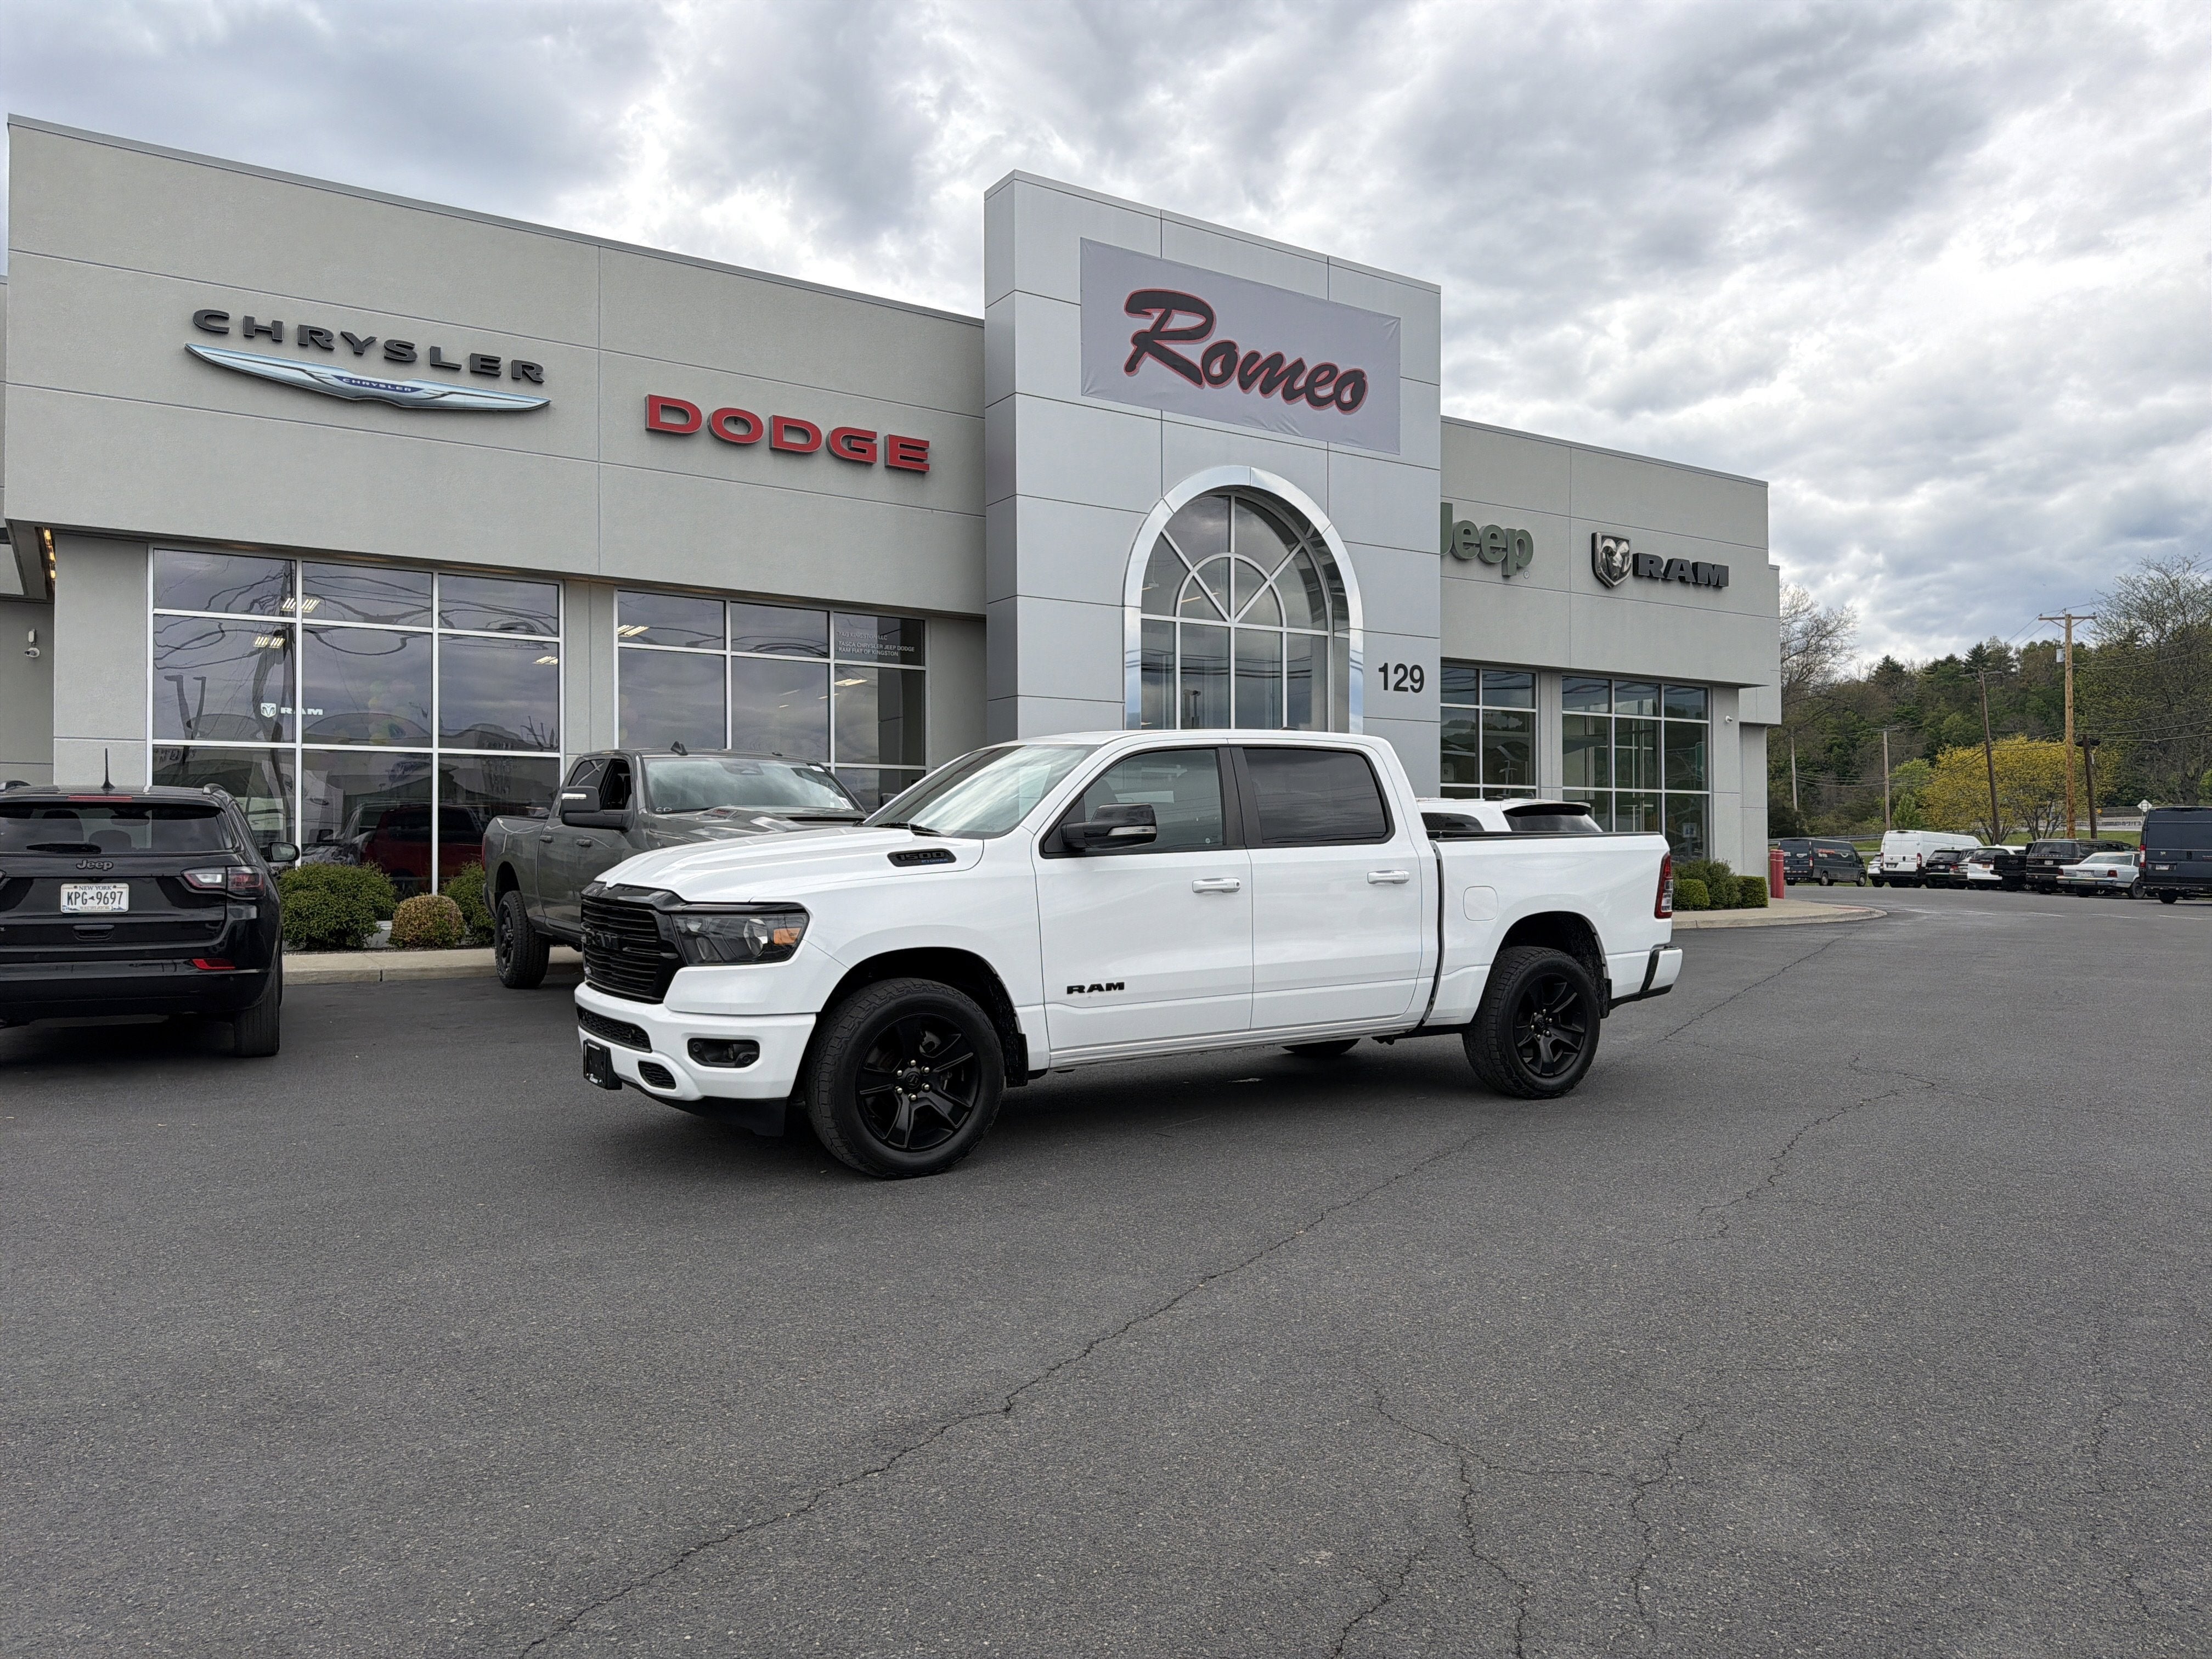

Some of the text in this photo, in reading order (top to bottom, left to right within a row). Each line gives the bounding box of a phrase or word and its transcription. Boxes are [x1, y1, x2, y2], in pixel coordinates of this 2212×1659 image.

[193, 309, 545, 384] CHRYSLER
[1124, 288, 1368, 415] Romeo
[342, 377, 412, 392] CHRYSLER
[645, 394, 930, 473] DODGE
[1632, 552, 1729, 588] RAM
[1378, 662, 1425, 693] 129
[76, 859, 114, 871] Jeep
[898, 851, 944, 860] 1500
[67, 891, 123, 905] KPG 9697
[1066, 982, 1125, 995] RAM
